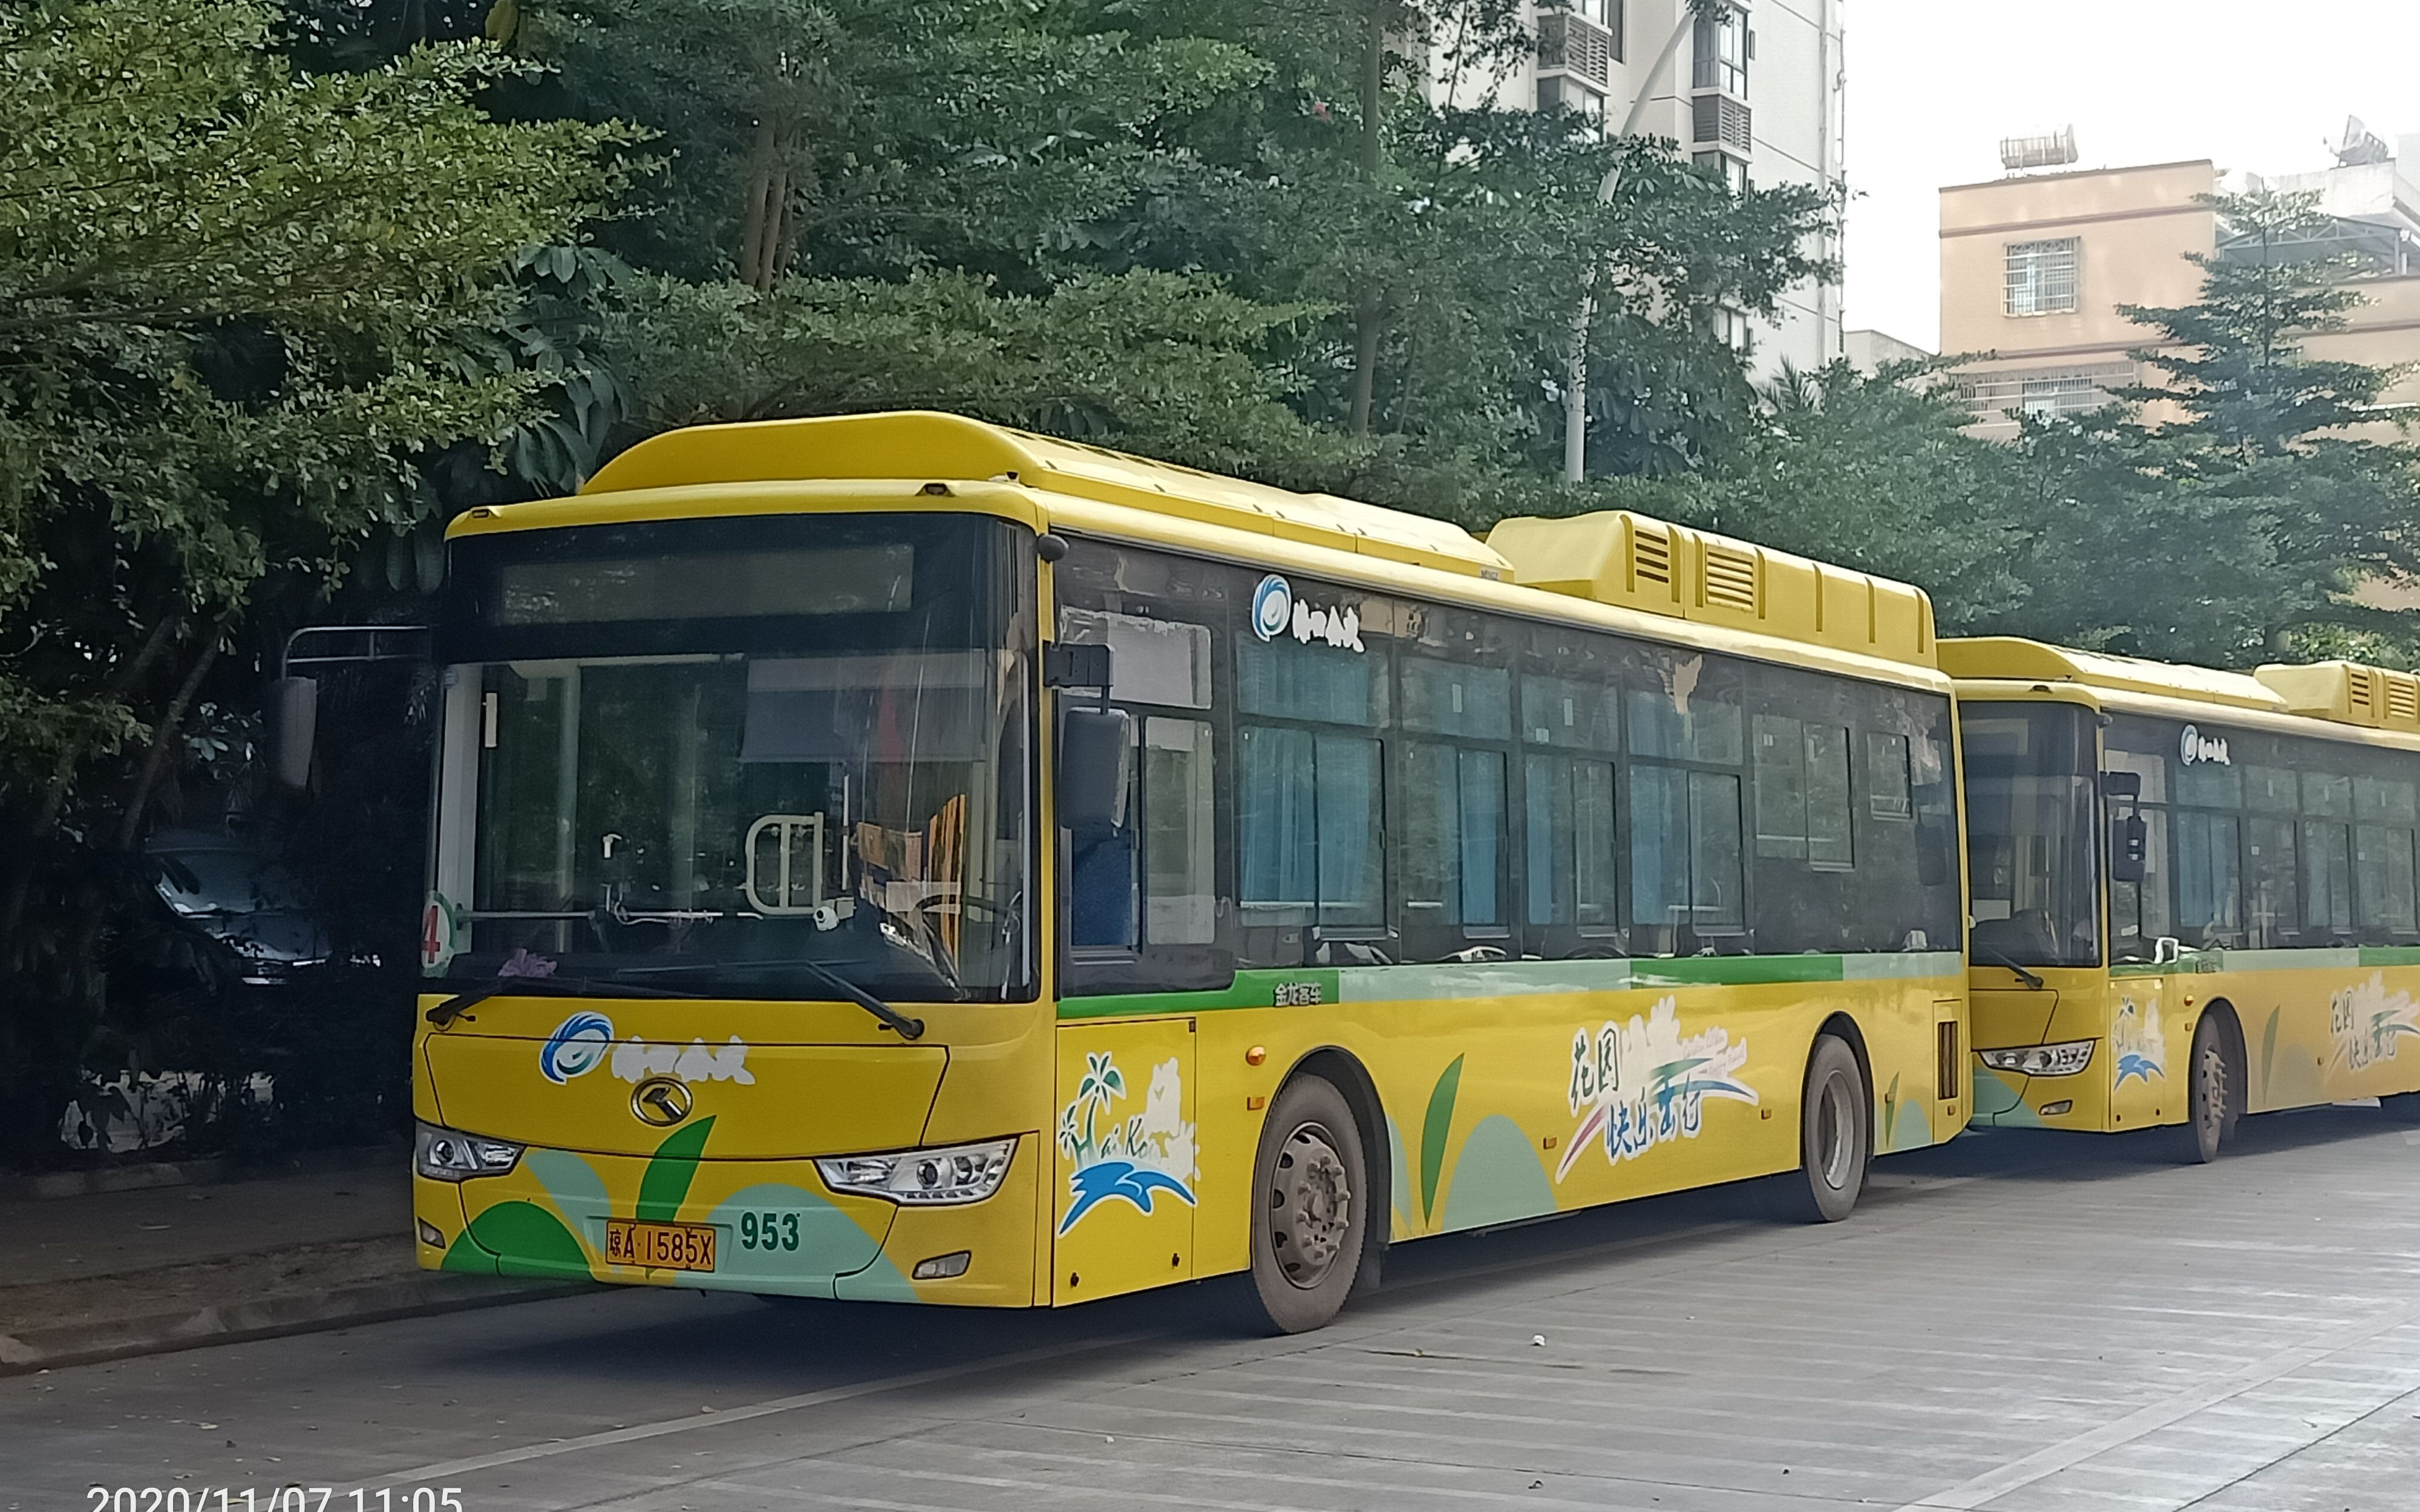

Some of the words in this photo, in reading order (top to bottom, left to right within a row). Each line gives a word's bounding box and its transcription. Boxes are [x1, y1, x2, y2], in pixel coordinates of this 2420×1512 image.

[423, 905, 440, 963] 4
[1274, 982, 1322, 1007] 金龙客车
[1571, 1028, 1619, 1109] 花园
[741, 1211, 799, 1251] 953
